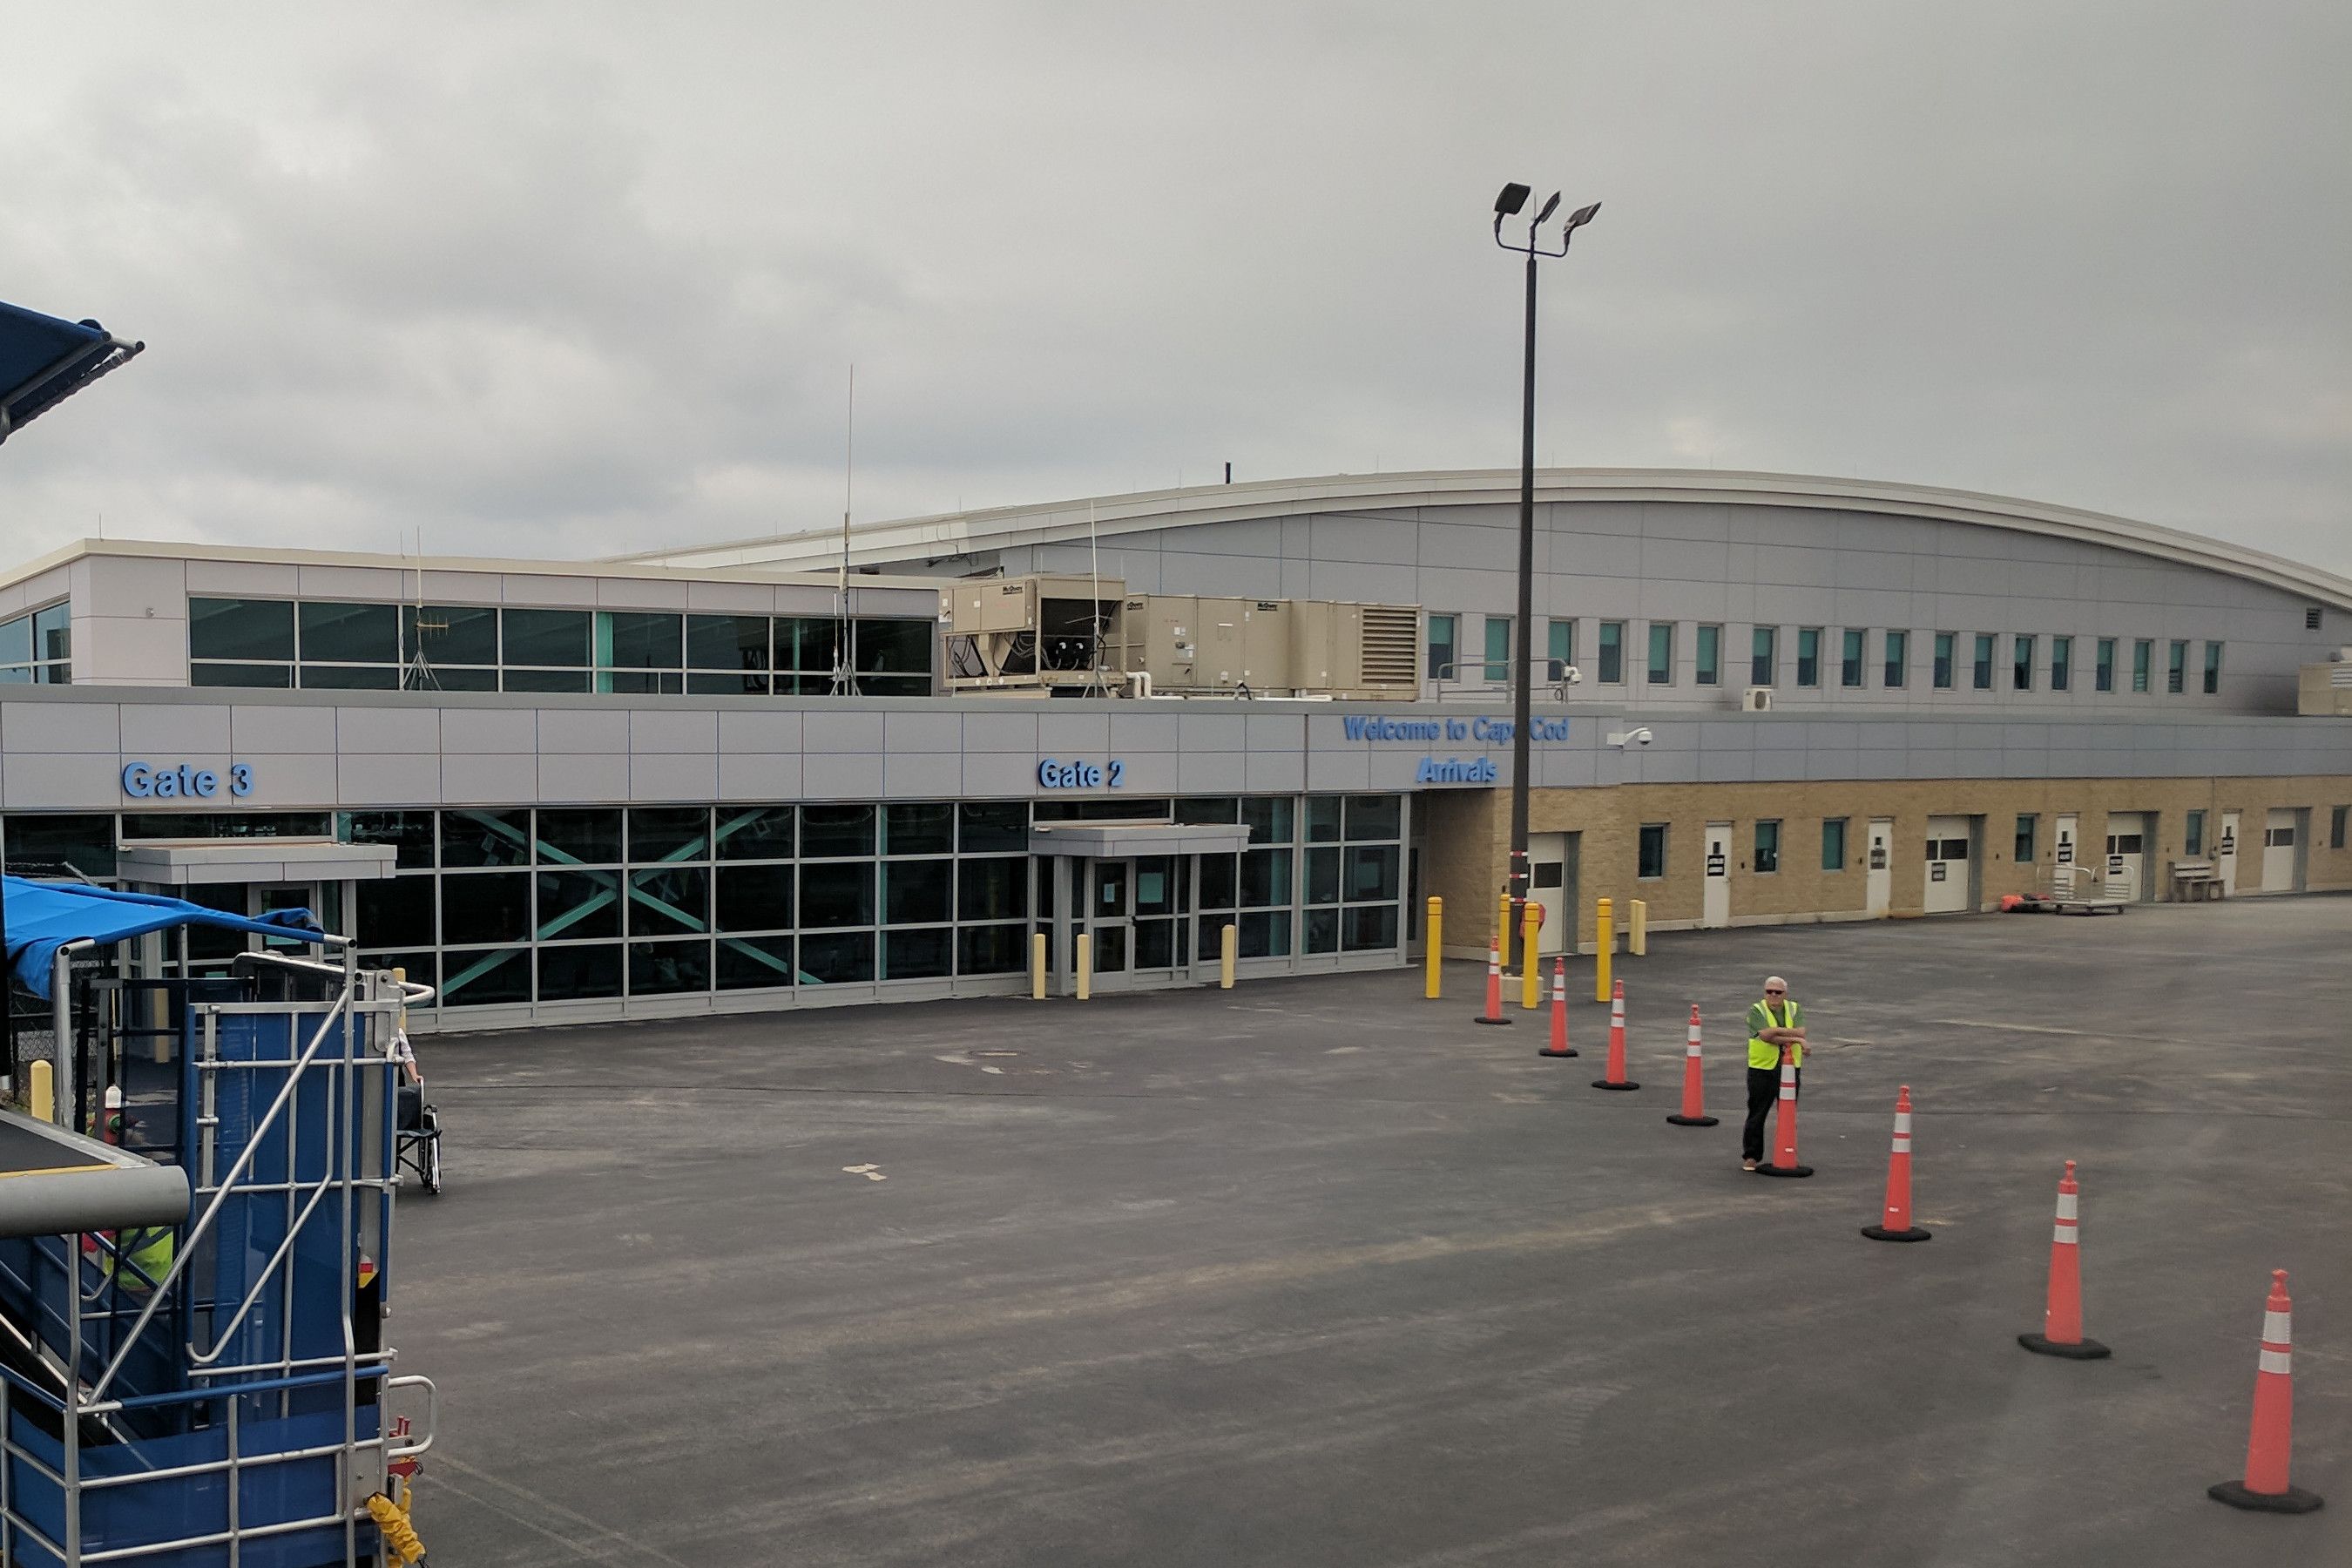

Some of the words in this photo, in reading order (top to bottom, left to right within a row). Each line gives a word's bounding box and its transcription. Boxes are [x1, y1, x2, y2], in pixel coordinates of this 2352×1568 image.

[1343, 714, 1440, 740] Welcome
[1445, 718, 1466, 740] to
[1472, 714, 1516, 746] Cap
[1529, 715, 1569, 740] Cod
[123, 761, 219, 798] Gate
[231, 764, 254, 797] 3
[1038, 758, 1102, 787] Gate
[1108, 759, 1125, 787] 2
[1416, 755, 1498, 783] Arrivals
